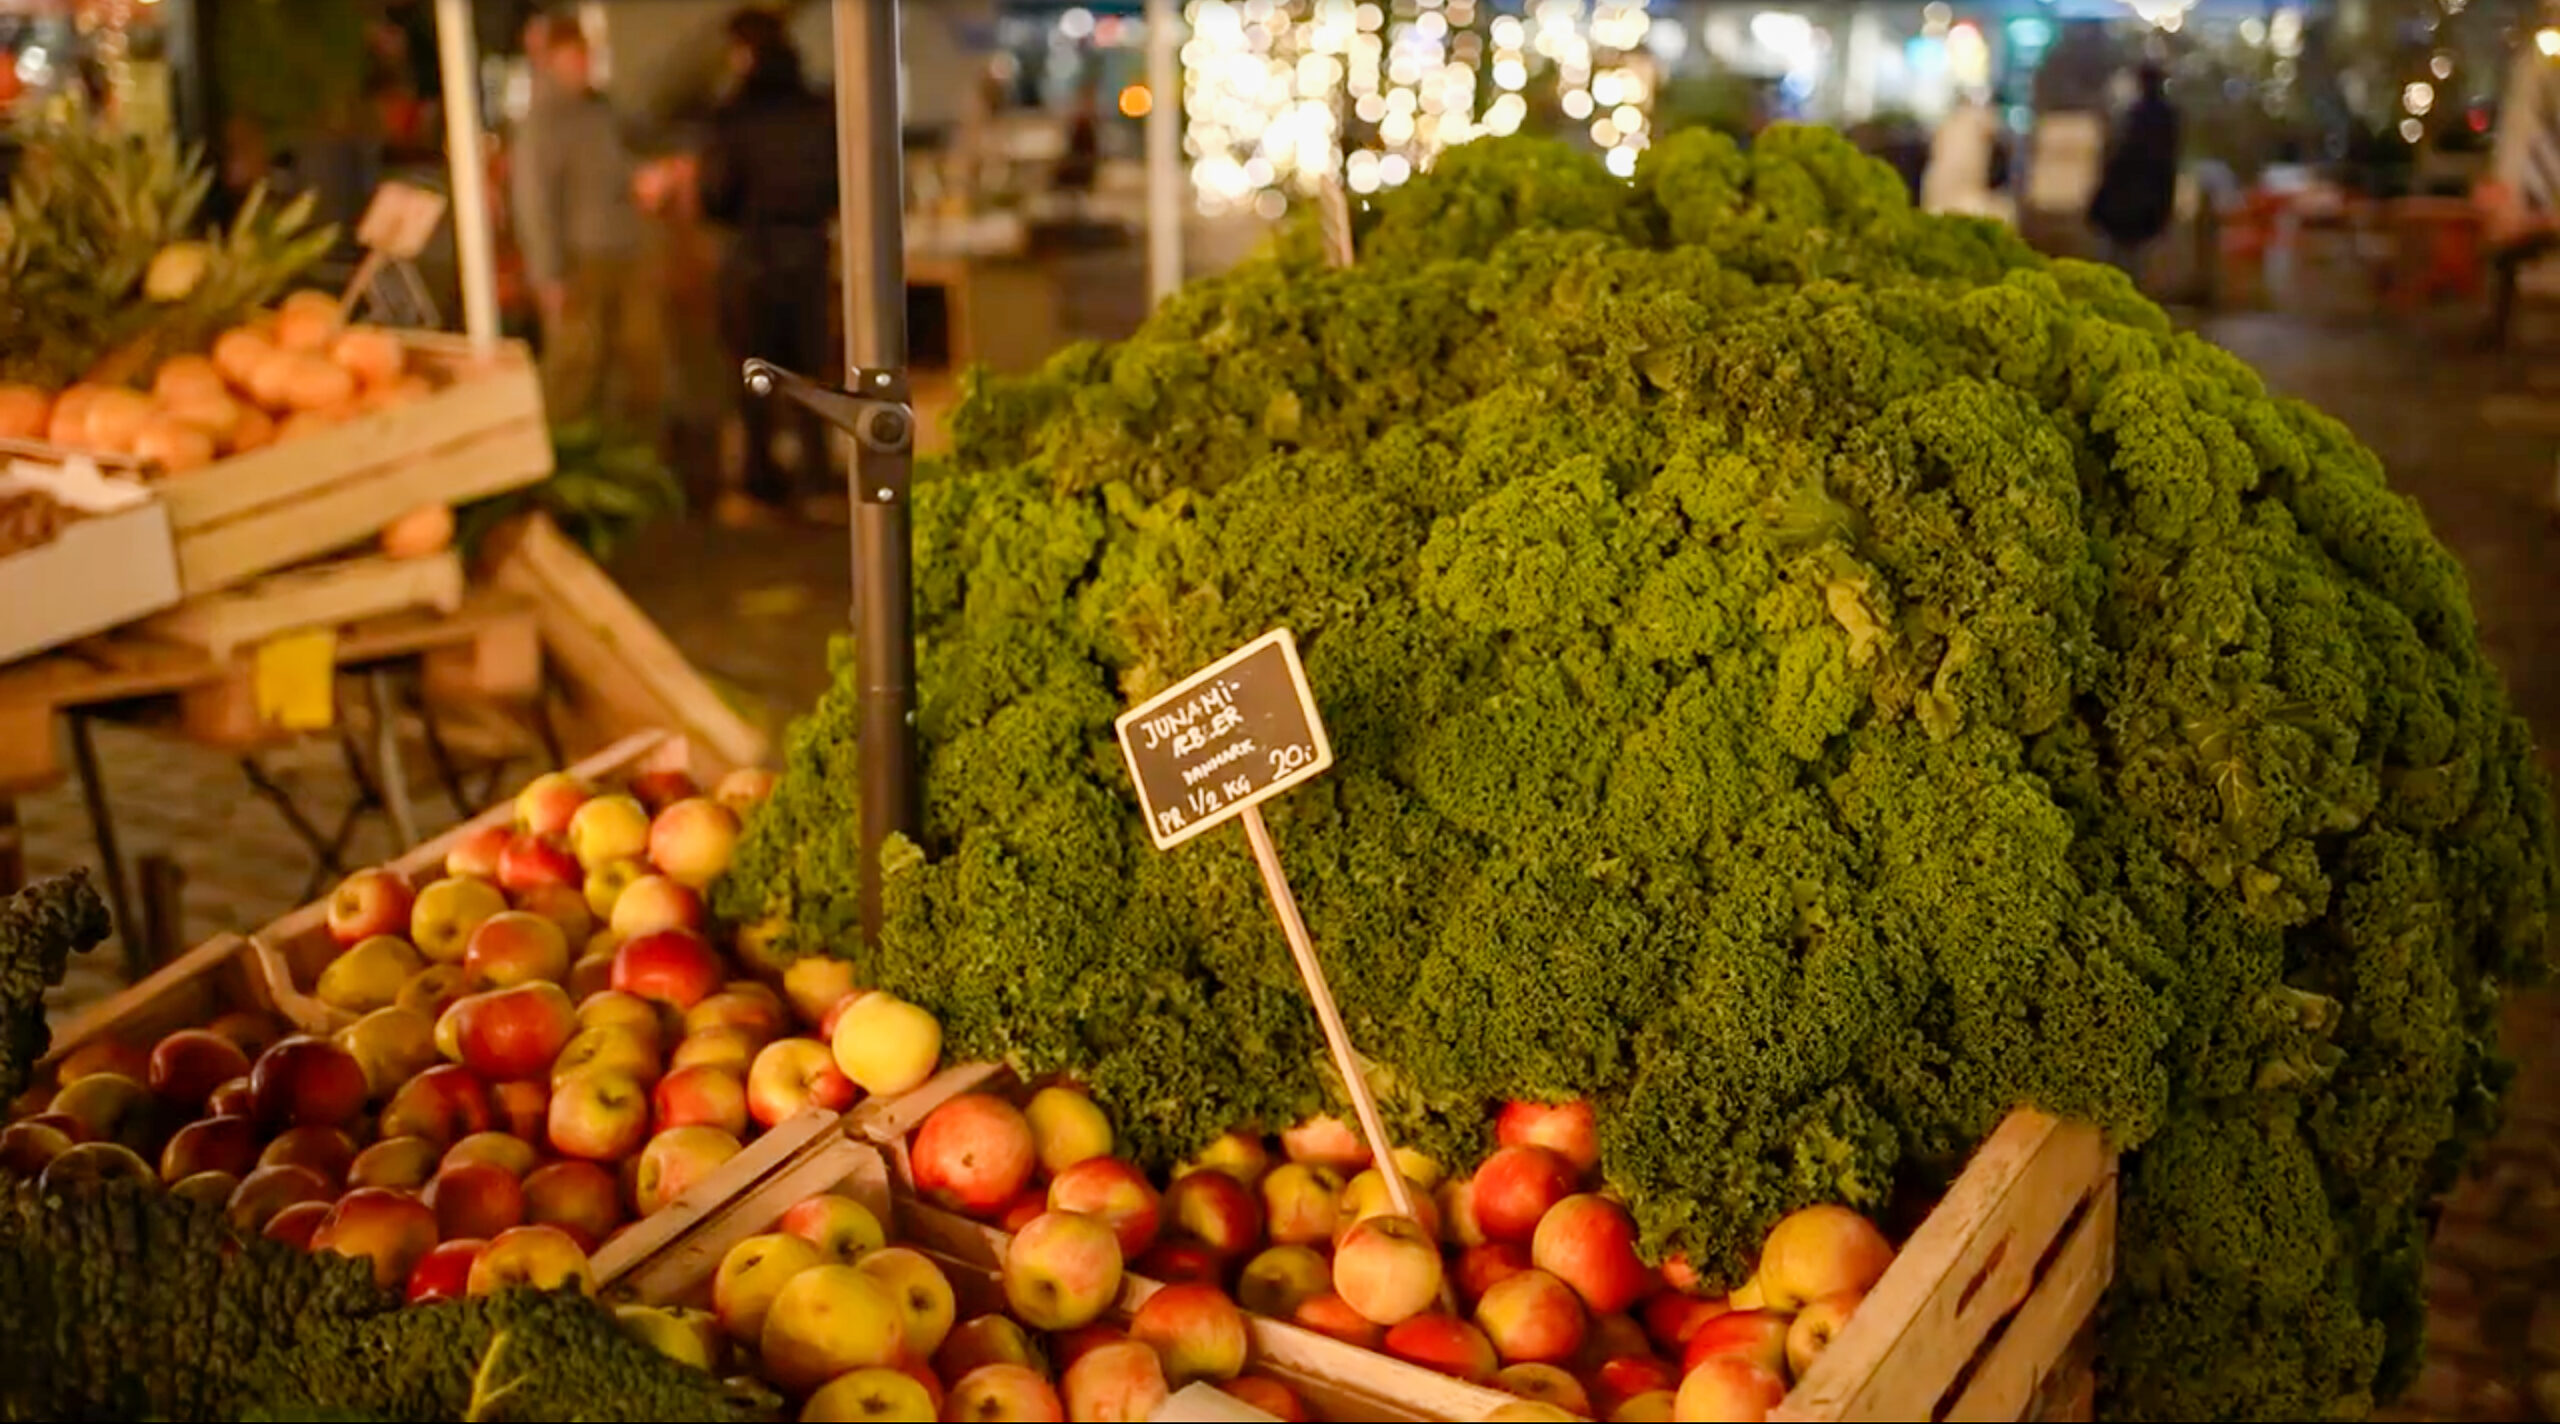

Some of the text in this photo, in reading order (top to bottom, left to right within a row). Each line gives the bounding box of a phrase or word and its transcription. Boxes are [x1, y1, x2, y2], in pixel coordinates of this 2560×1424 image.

[1181, 739, 1256, 786] DANMARK
[1158, 806, 1187, 835] PR
[1187, 787, 1223, 816] 1/2
[1222, 774, 1251, 801] KG
